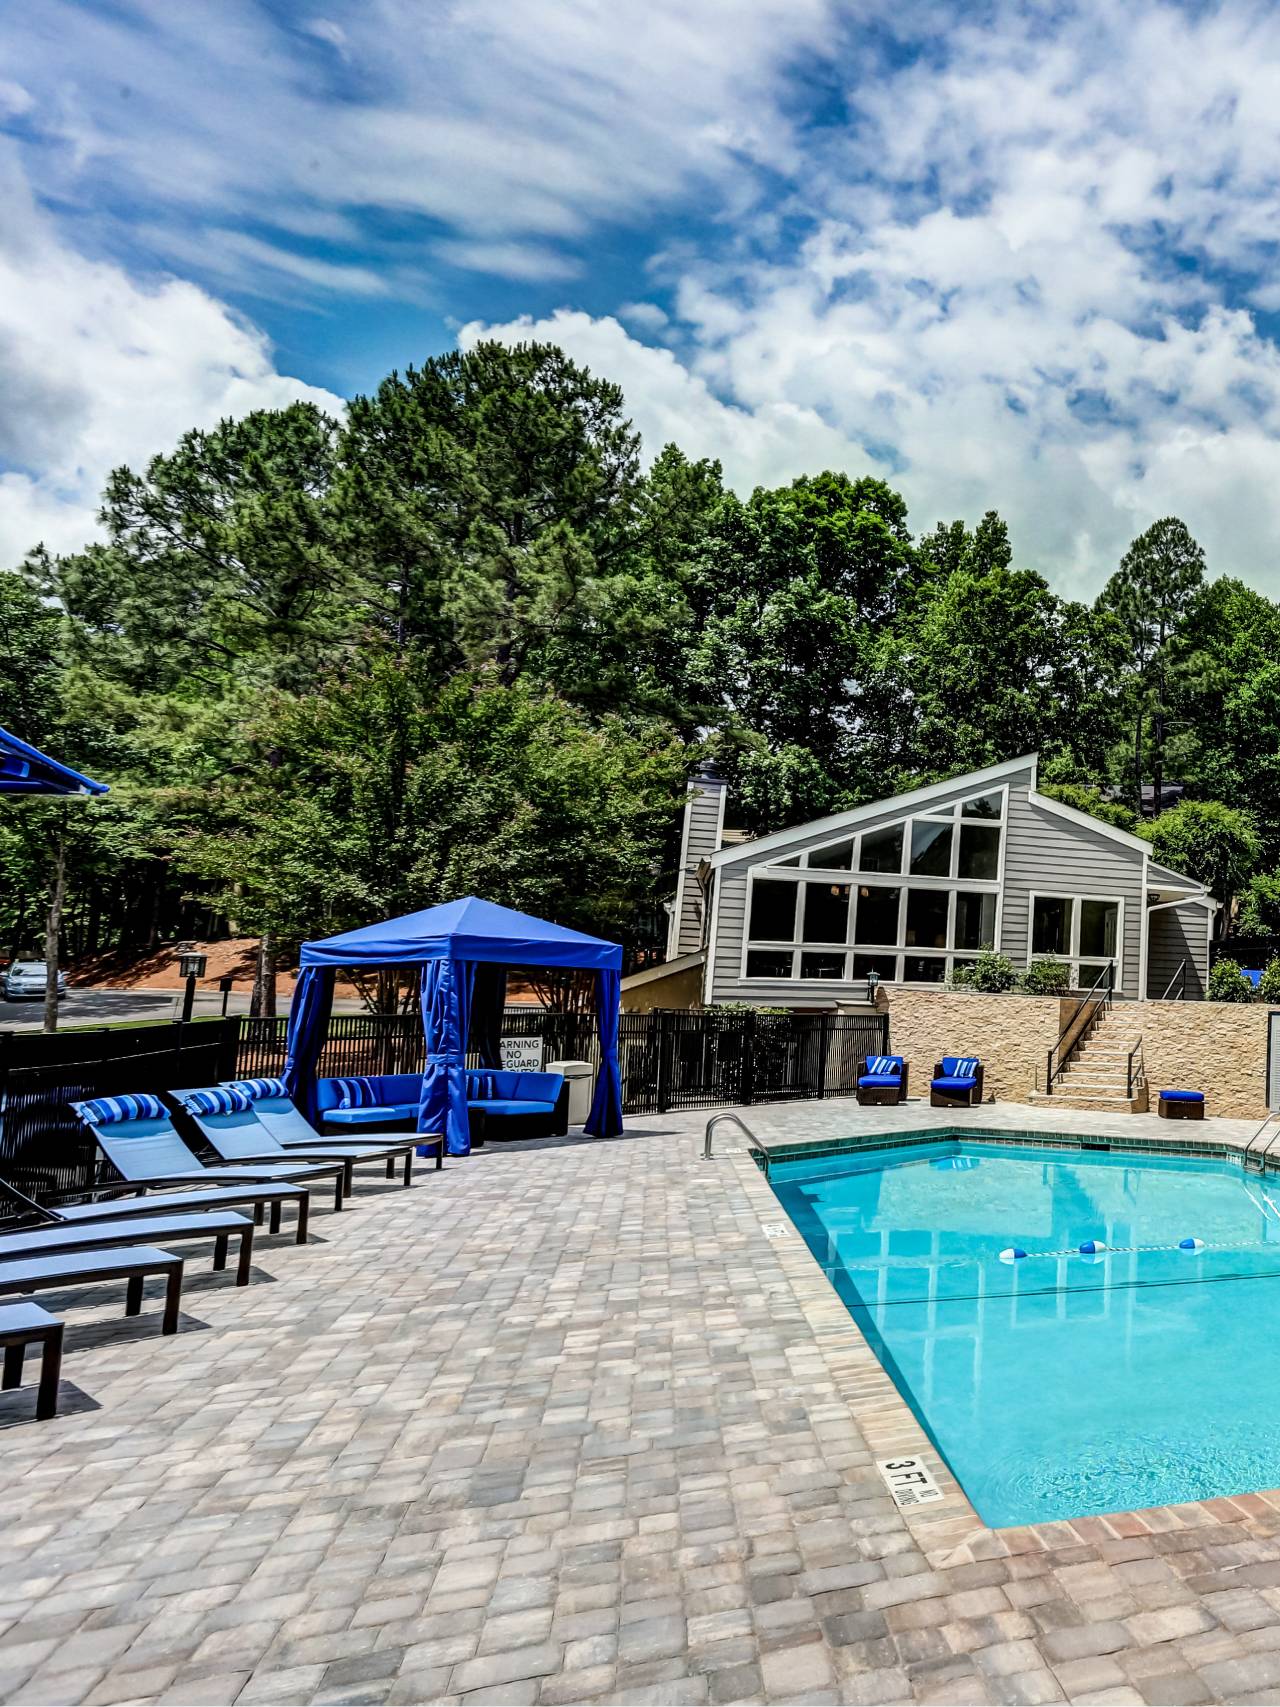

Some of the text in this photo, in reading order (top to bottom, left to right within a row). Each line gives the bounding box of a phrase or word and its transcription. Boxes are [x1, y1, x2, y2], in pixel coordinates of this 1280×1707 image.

[500, 1040, 539, 1048] ARNING
[506, 1050, 522, 1059] NO
[501, 1059, 539, 1068] EGUARD
[885, 1460, 916, 1470] 3
[890, 1471, 928, 1486] FT
